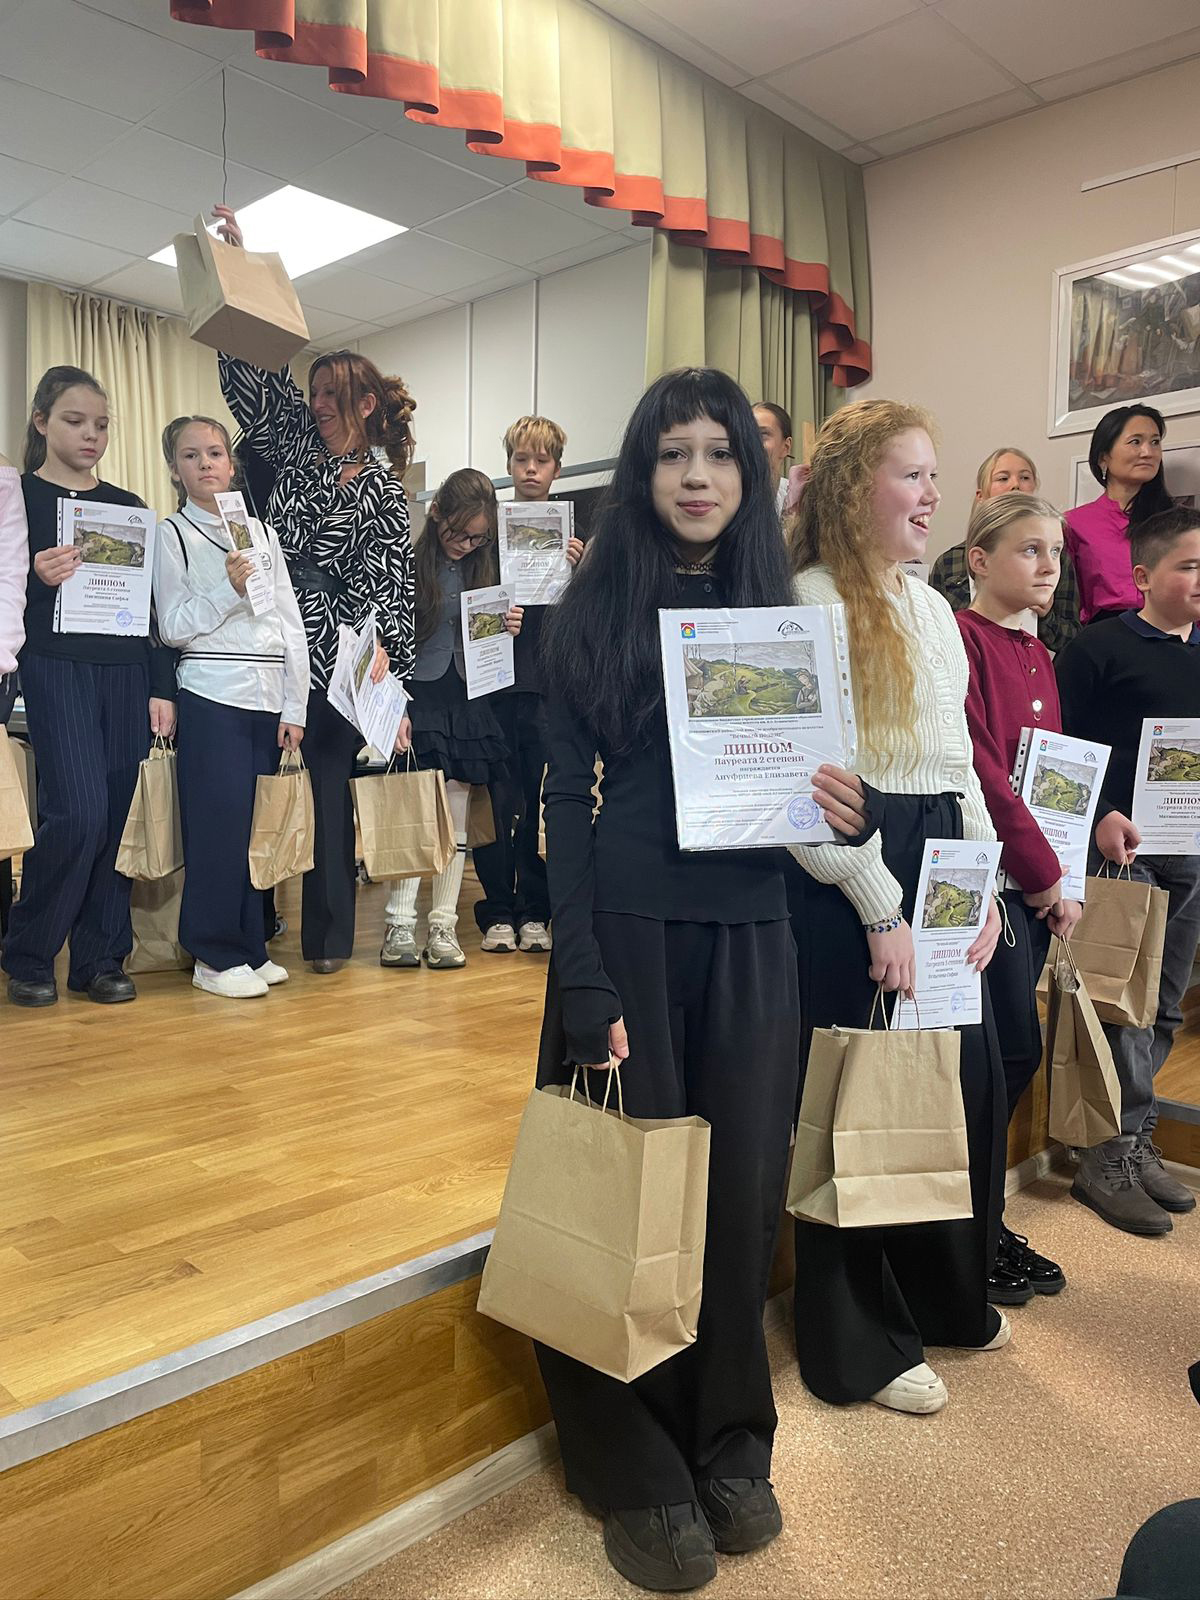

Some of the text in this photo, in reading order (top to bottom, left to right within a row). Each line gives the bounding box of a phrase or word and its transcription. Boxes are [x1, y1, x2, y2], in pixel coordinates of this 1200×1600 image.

[88, 578, 125, 587] ДИПЛОМ
[723, 742, 793, 756] ДИПЛОМ
[714, 755, 804, 766] Лауреата 2 степени
[714, 771, 809, 782] Ануфриева Елизавета
[931, 949, 961, 960] ДИПЛОМ
